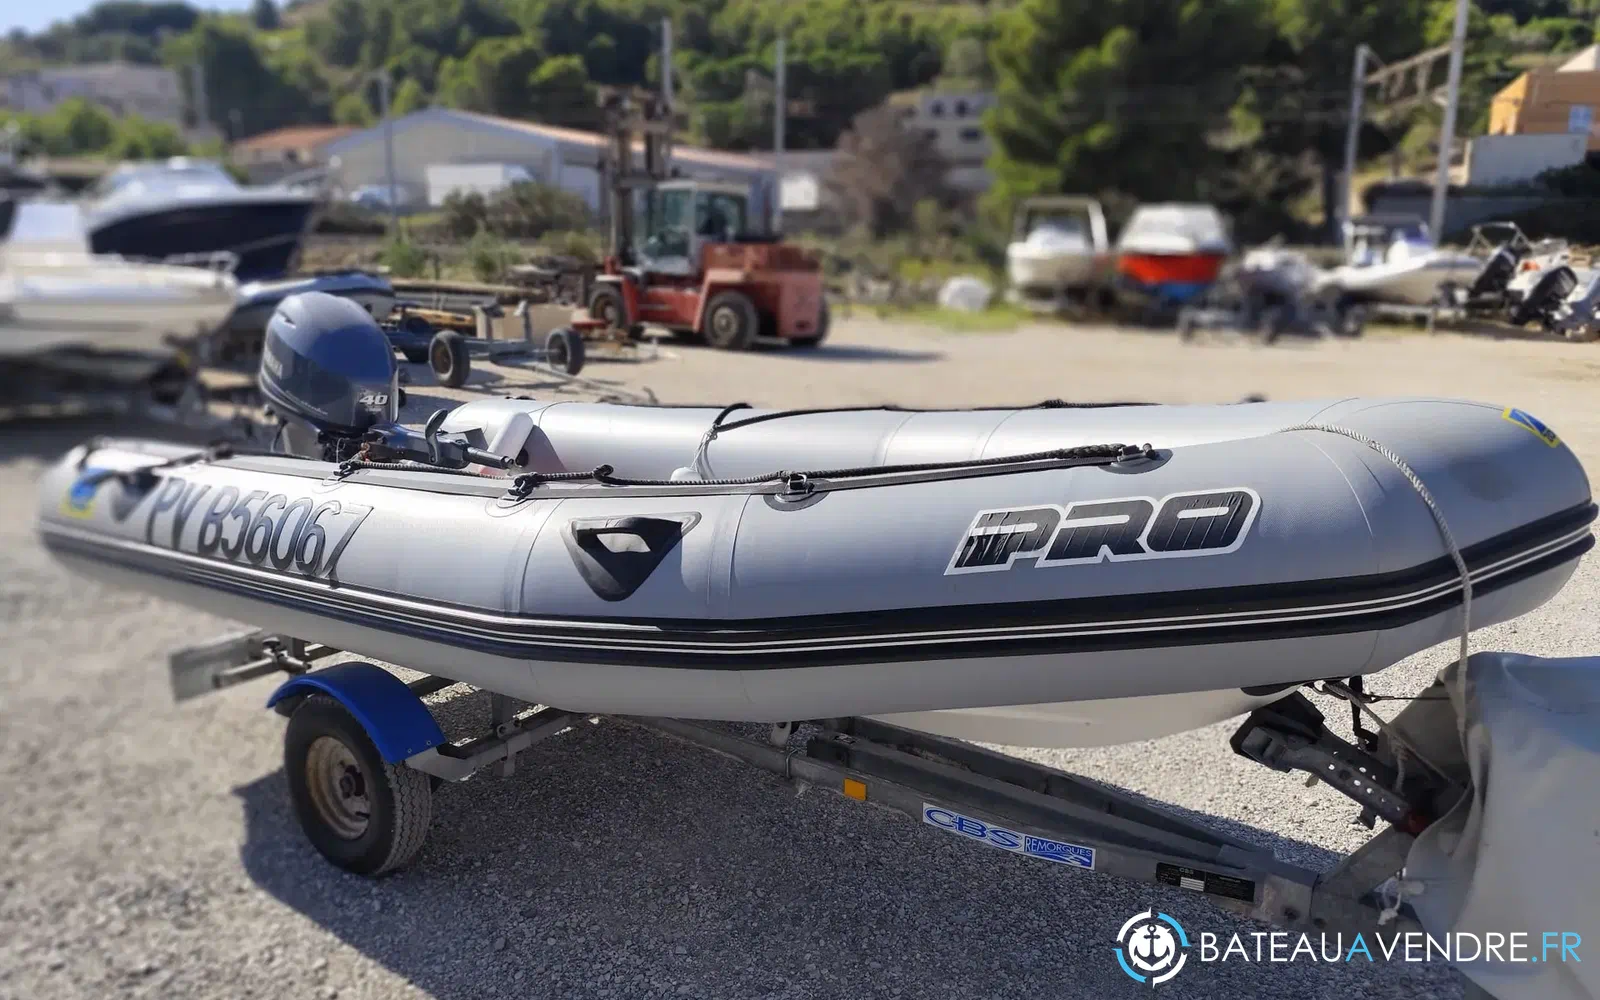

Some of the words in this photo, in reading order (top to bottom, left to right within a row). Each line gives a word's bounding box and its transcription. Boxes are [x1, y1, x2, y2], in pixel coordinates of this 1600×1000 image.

[359, 394, 388, 405] 40
[146, 477, 211, 551] PV
[197, 486, 374, 579] B56067
[945, 488, 1263, 575] PRO
[925, 808, 1023, 849] CBS
[1026, 837, 1092, 857] REMORQUES
